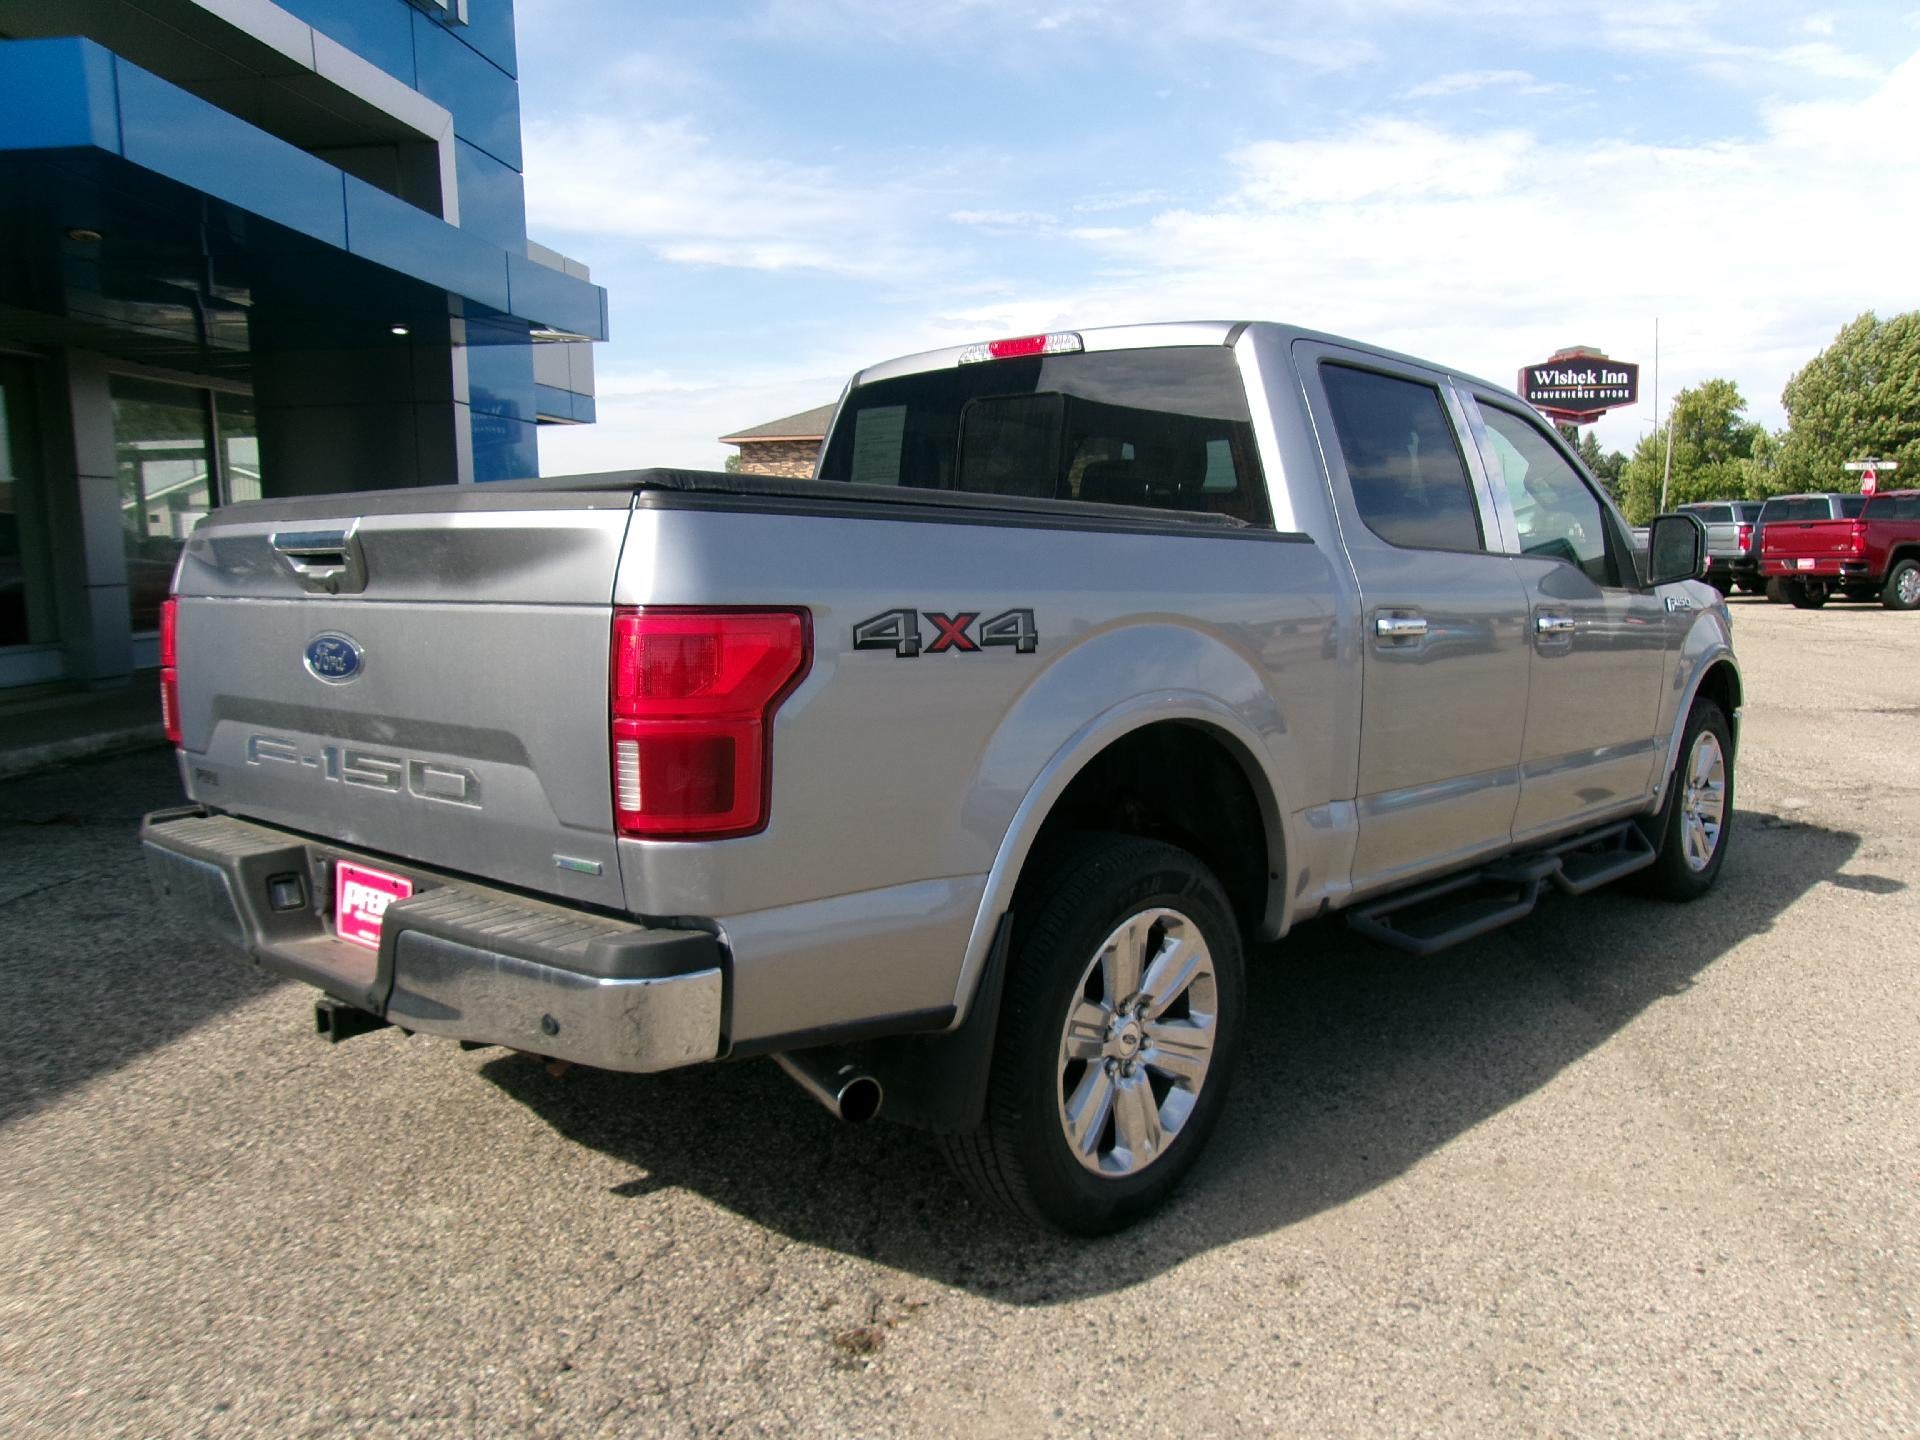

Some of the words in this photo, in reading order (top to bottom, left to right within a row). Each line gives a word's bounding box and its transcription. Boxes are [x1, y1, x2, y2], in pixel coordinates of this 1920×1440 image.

[1534, 369, 1597, 385] Wishek
[1601, 369, 1628, 384] Inn
[1530, 389, 1595, 399] CONVENIENCE
[1600, 389, 1629, 399] STORE
[1861, 477, 1874, 491] STOP
[314, 641, 347, 672] Ford
[247, 733, 482, 810] F-150
